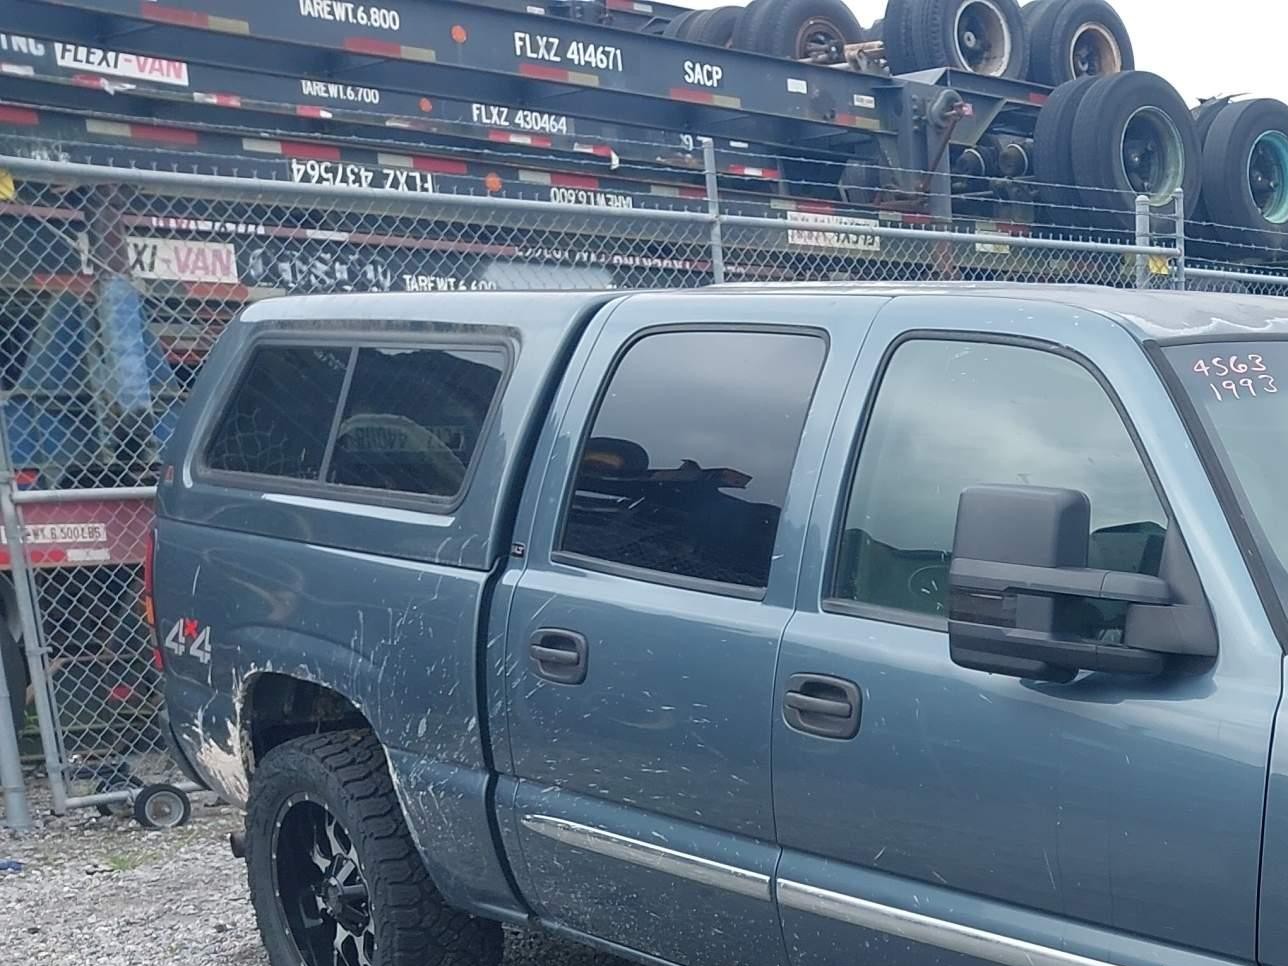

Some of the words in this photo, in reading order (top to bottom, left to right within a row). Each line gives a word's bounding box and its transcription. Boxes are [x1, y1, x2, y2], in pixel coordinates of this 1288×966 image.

[59, 43, 184, 80] FLEXI-VAN
[513, 31, 561, 62] FLXZ
[566, 40, 623, 72] 414671
[683, 60, 723, 88] SACP
[472, 103, 510, 126] FLXZ
[514, 109, 567, 135] 430464
[291, 158, 373, 188] 437564
[383, 169, 433, 193] FLXZ
[1193, 354, 1267, 376] 4563
[1210, 374, 1278, 401] 1993
